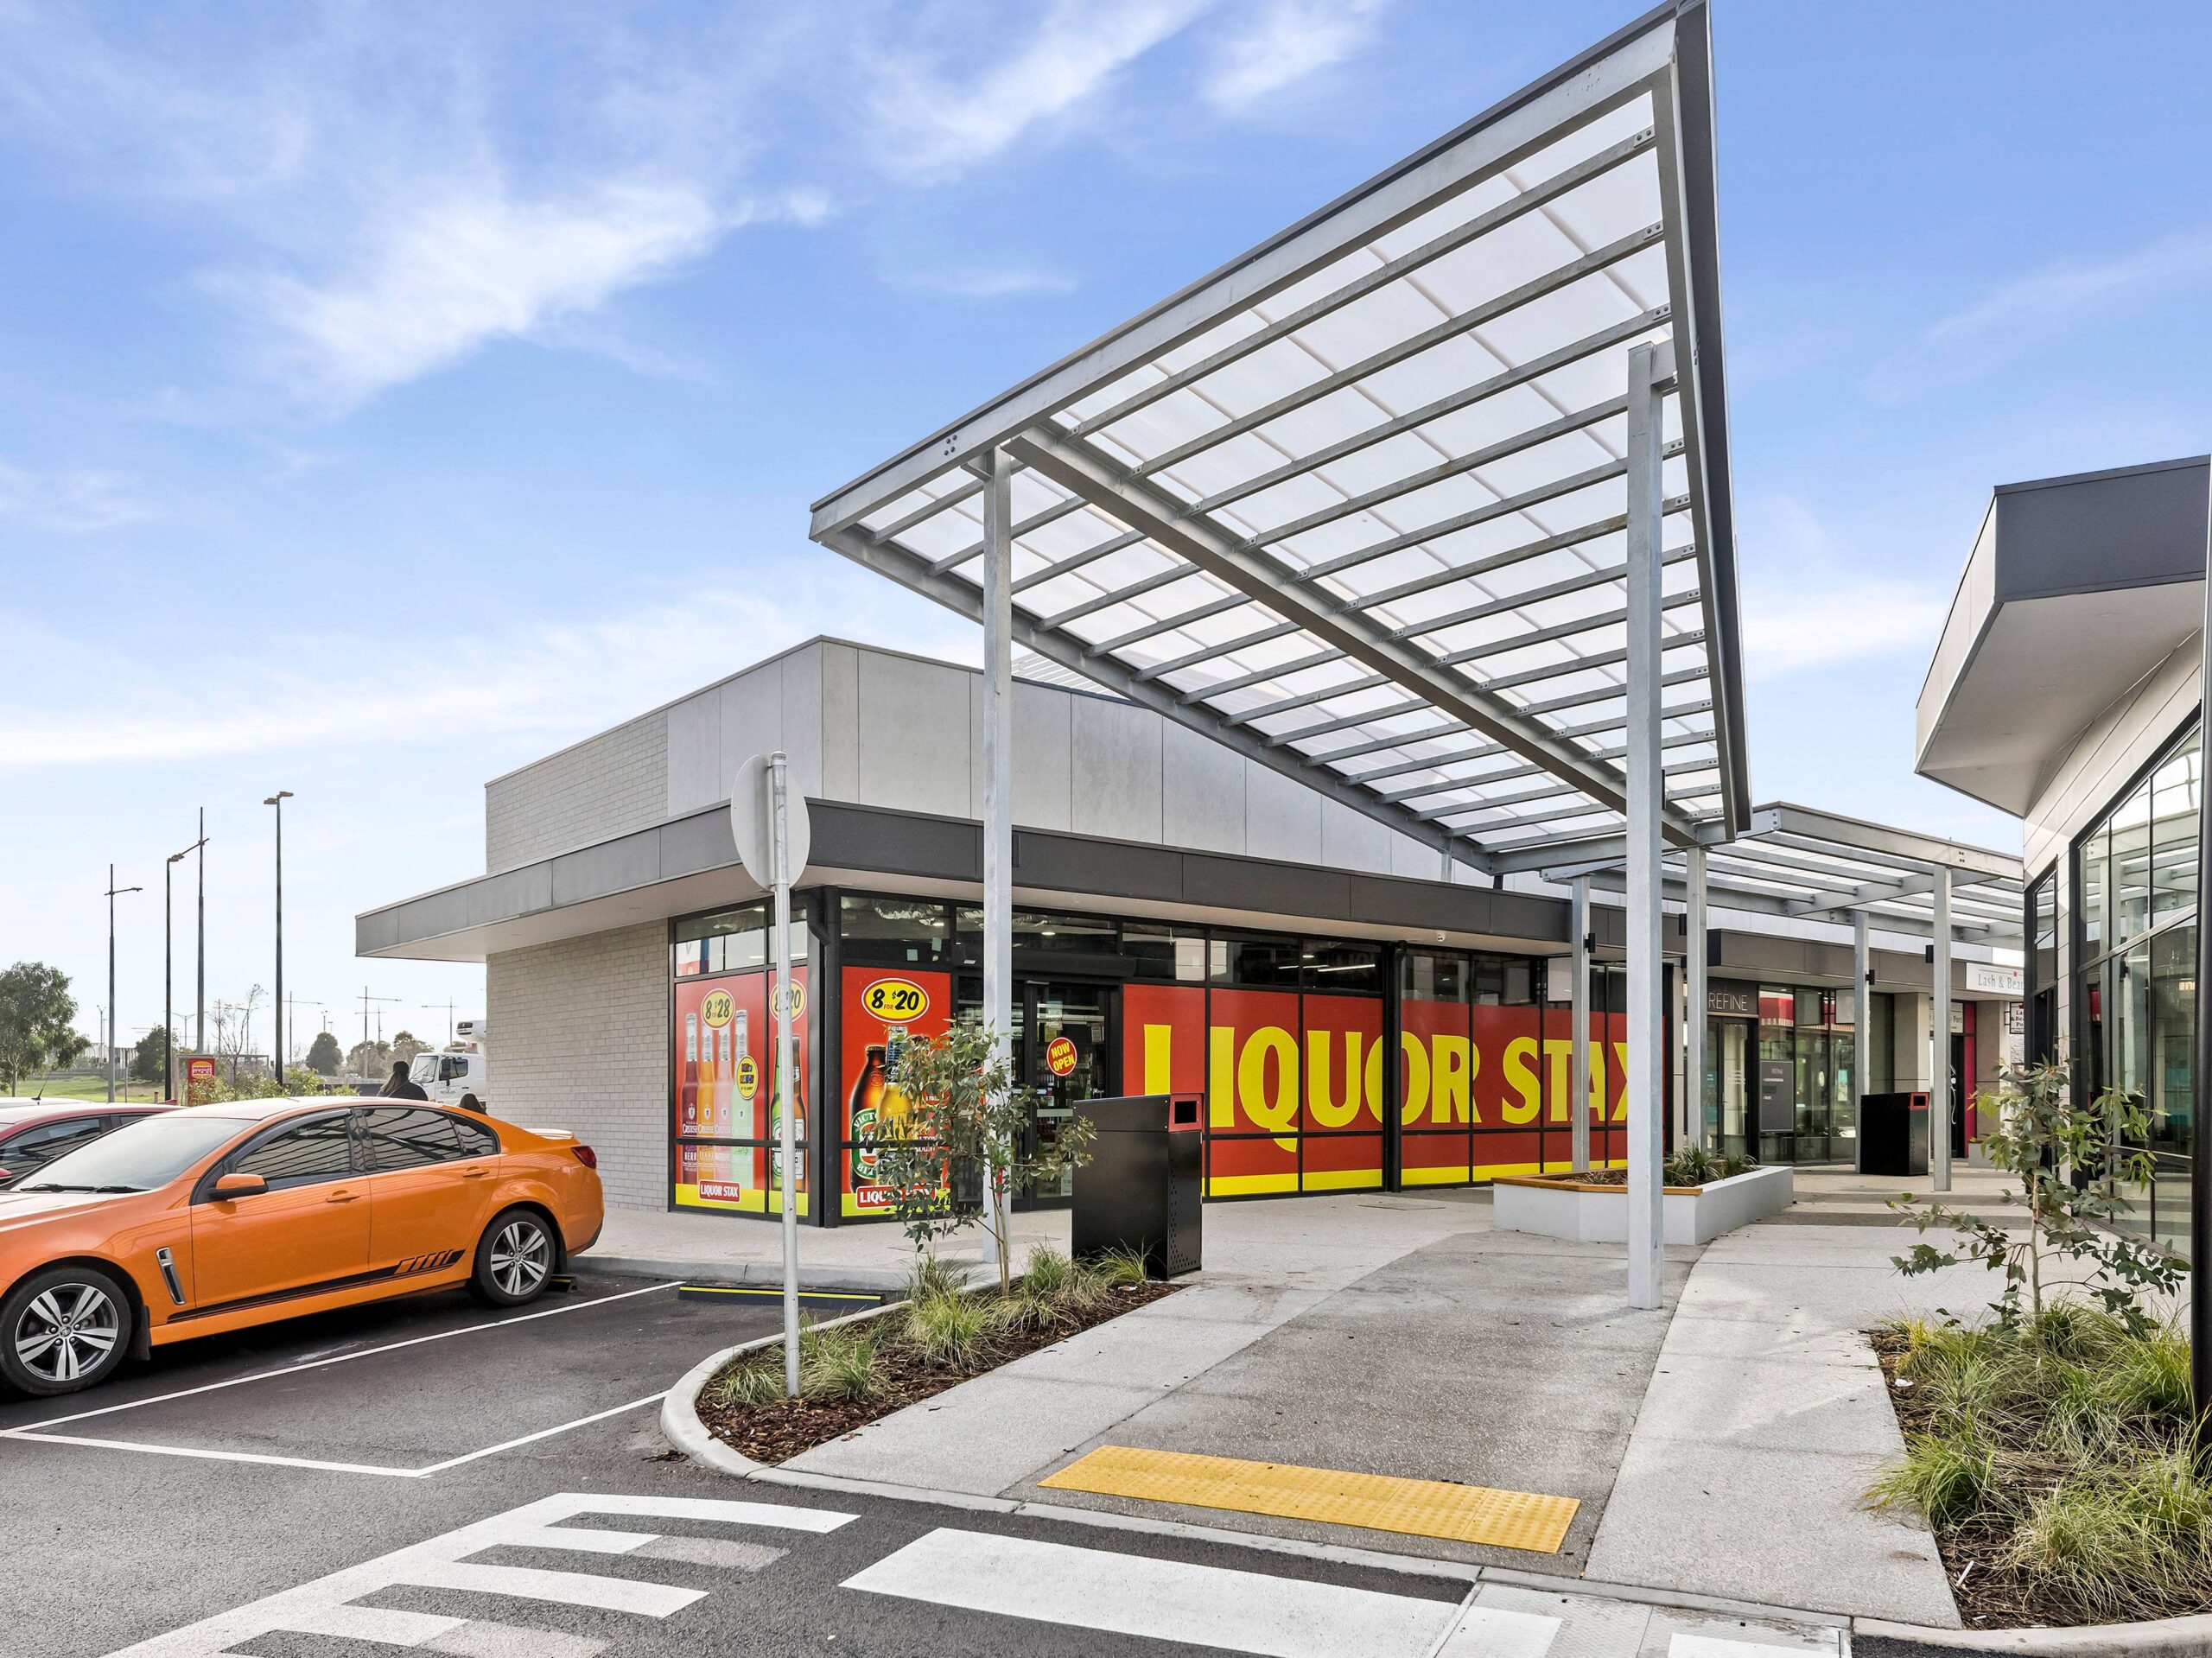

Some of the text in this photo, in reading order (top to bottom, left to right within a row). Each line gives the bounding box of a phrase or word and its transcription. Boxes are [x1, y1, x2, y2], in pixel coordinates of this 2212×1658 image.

[1978, 973, 1996, 988] Lash
[1998, 975, 2005, 988] &
[871, 988, 885, 1009] 8
[892, 989, 919, 1011] $20
[1708, 993, 1748, 1012] REFINE
[705, 1000, 712, 1020] 8
[1051, 1042, 1071, 1059] NOW
[1053, 1054, 1075, 1072] OPEN
[700, 1185, 739, 1198] LIQUOR STAX
[860, 1189, 902, 1204] LIQU
